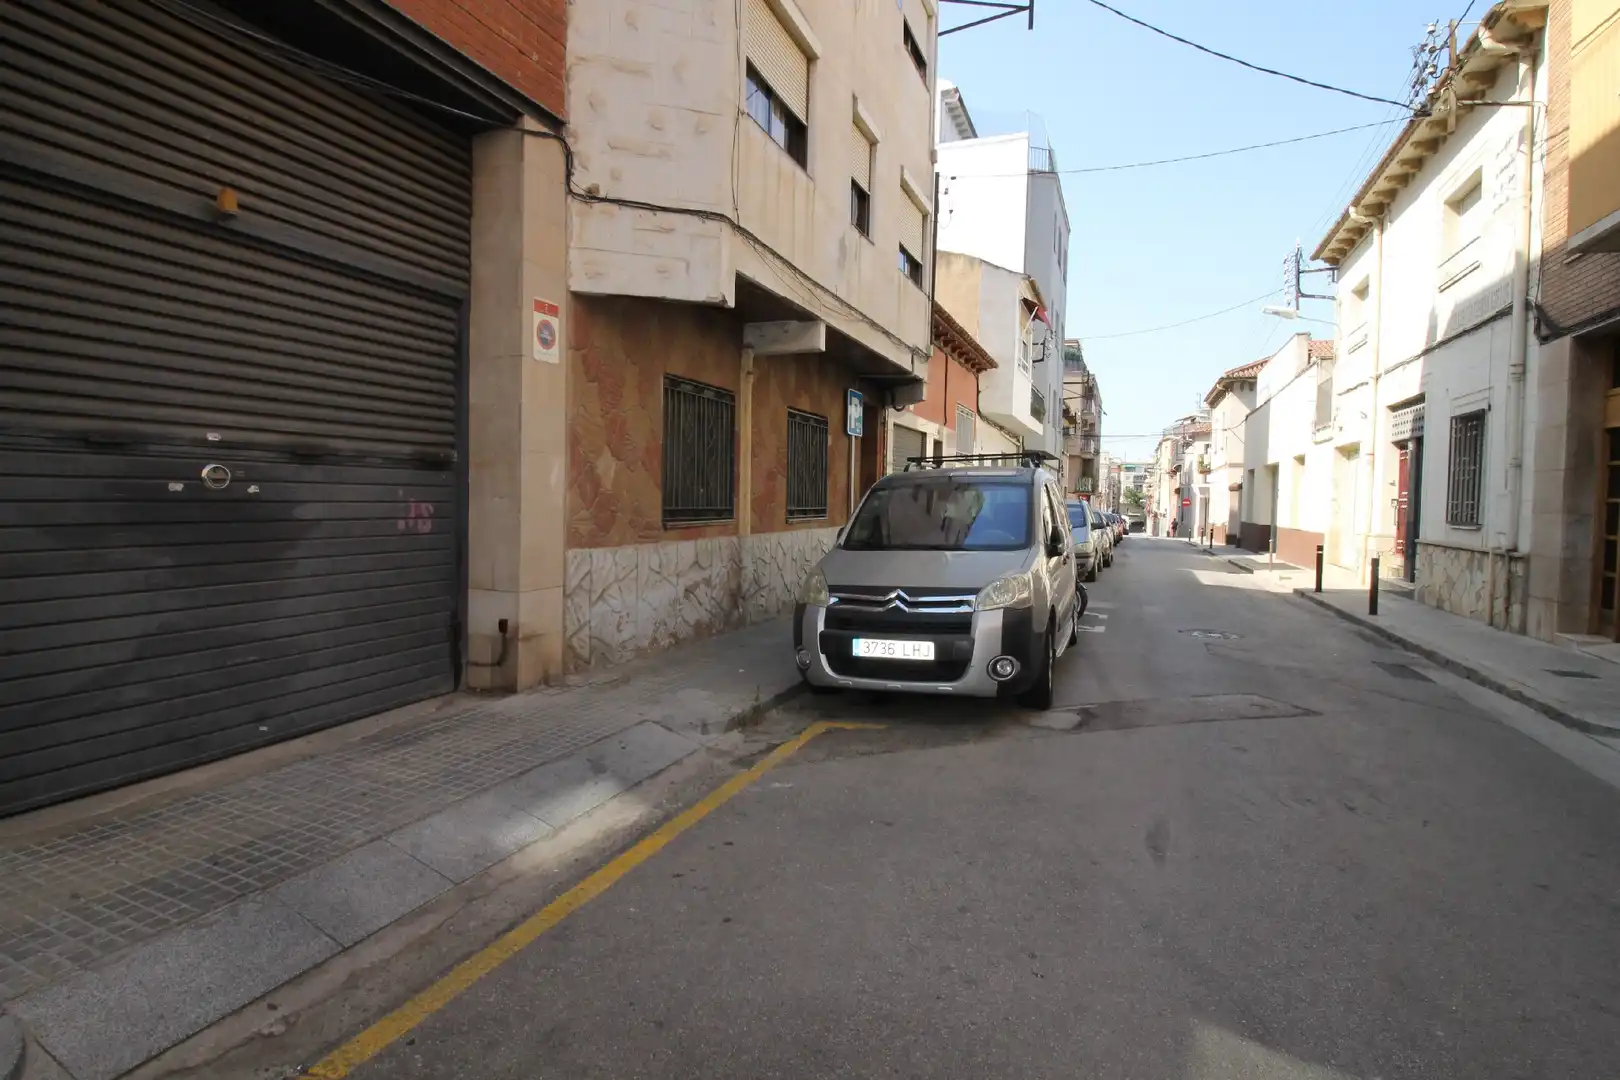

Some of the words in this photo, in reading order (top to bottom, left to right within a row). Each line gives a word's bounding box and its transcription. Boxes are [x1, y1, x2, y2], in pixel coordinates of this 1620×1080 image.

[851, 397, 860, 428] P
[863, 641, 895, 655] 3736
[902, 644, 931, 657] LHJ
